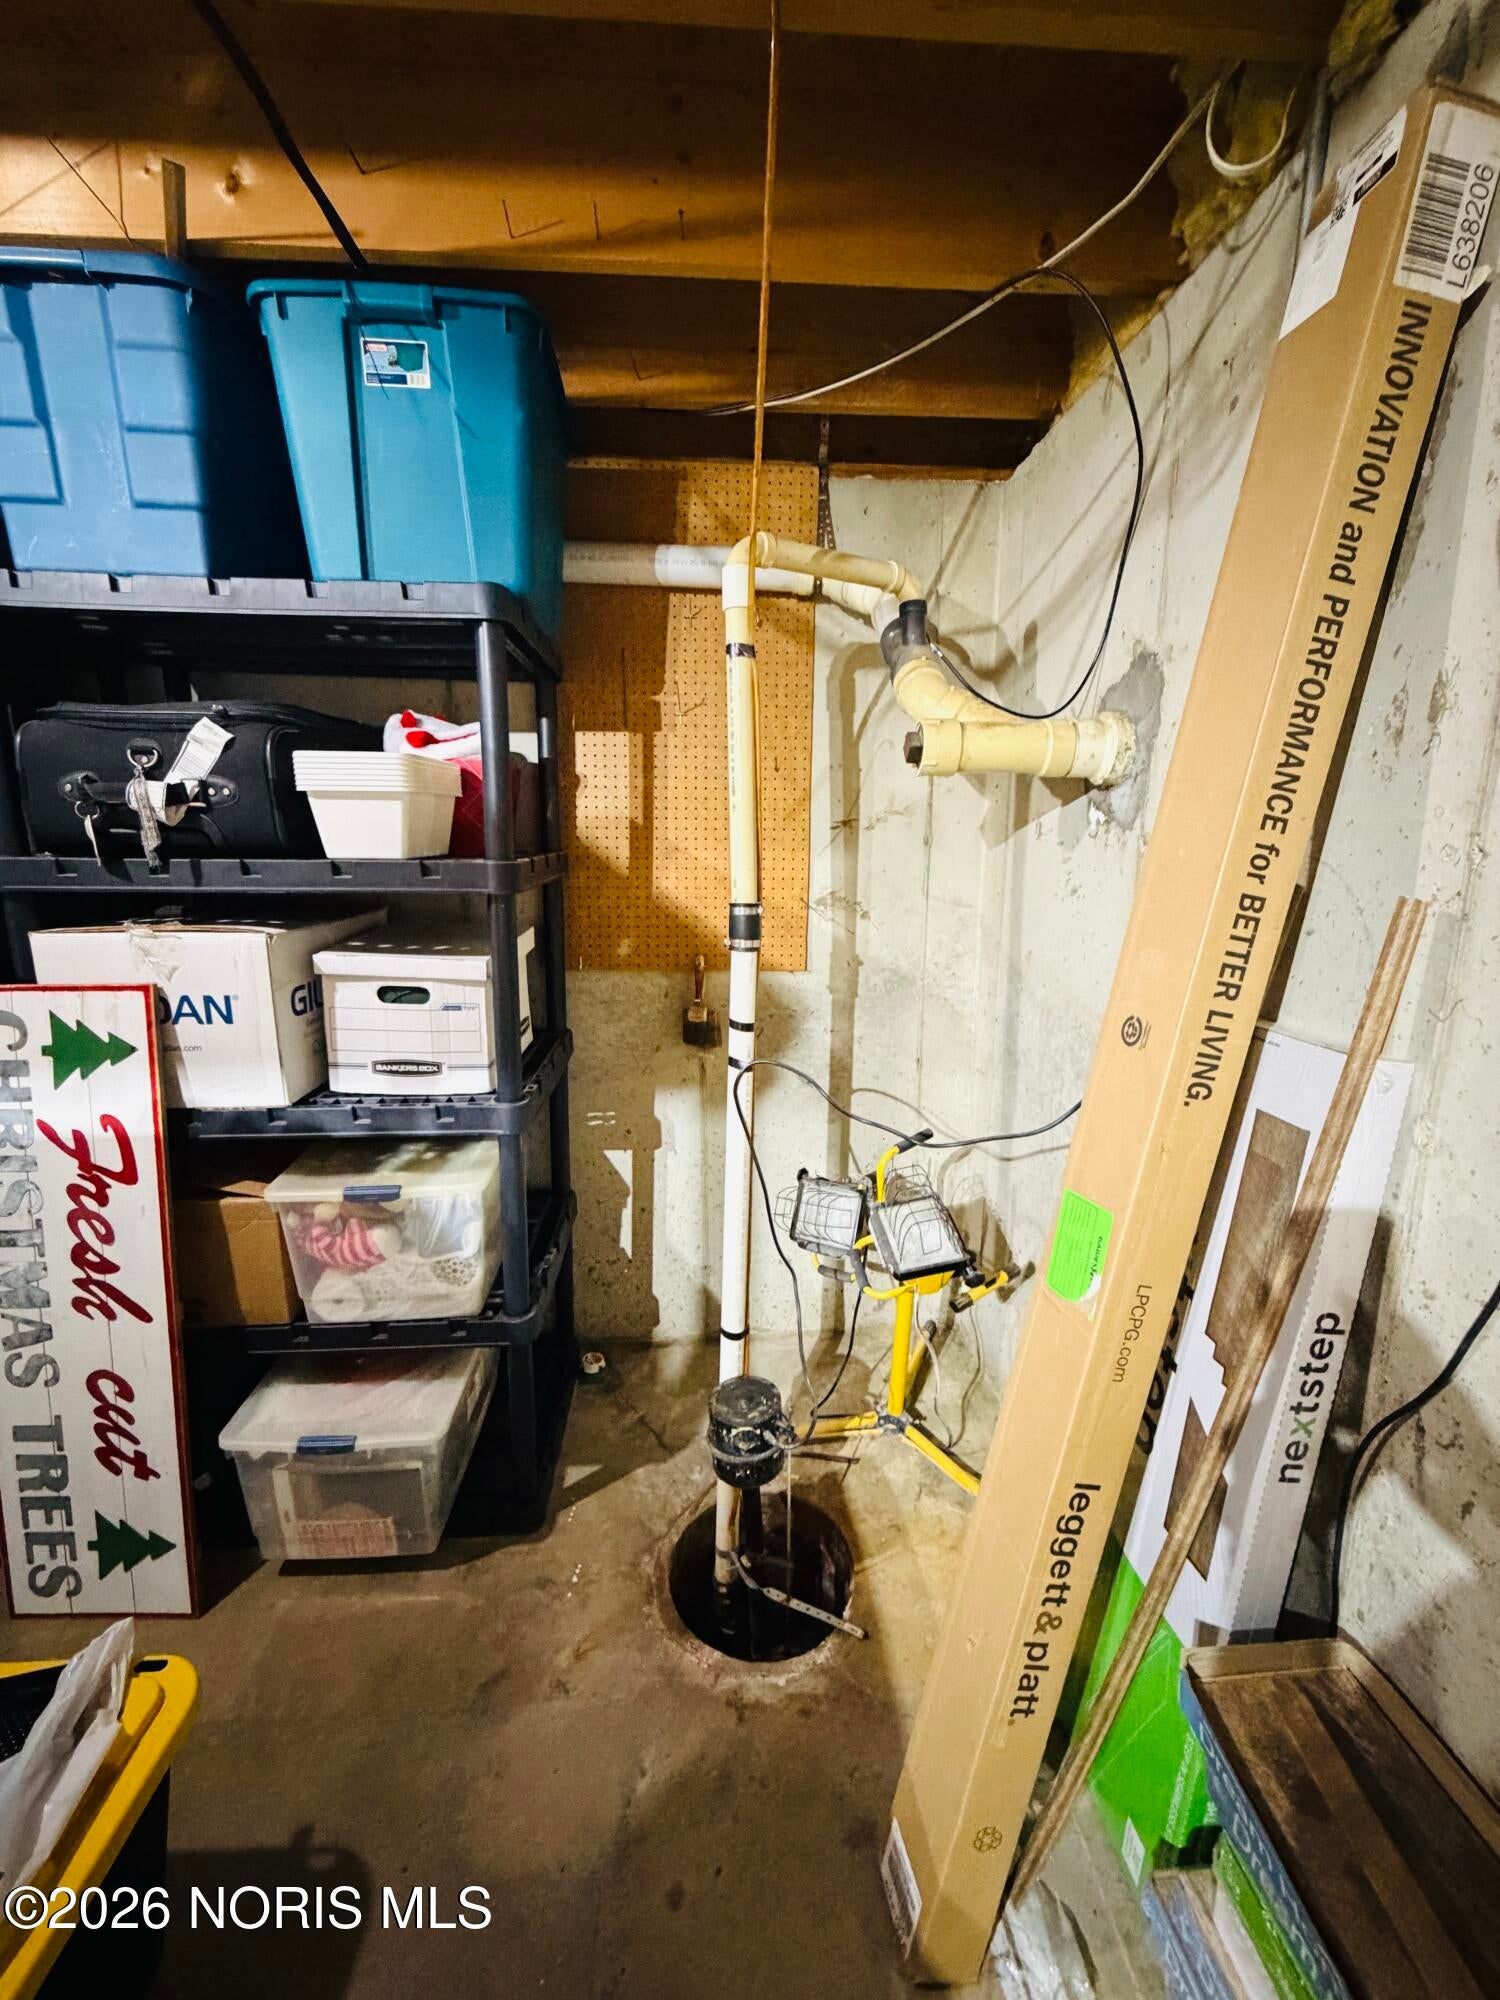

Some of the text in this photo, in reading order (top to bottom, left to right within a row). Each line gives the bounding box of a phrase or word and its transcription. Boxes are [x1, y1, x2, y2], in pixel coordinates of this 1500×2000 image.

[1447, 163, 1494, 289] L638206
[1184, 299, 1432, 1108] INNOVATION and PERFORMANCE for BETTER LIVING.
[375, 1064, 439, 1073] BANKERS BOX
[0, 1009, 83, 1599] CHRISTMAS TREES
[36, 1113, 162, 1482] Fresh cut
[1112, 1284, 1153, 1384] LPCPG.com
[1278, 1312, 1346, 1484] nextstep
[1041, 1482, 1102, 1608] leggett
